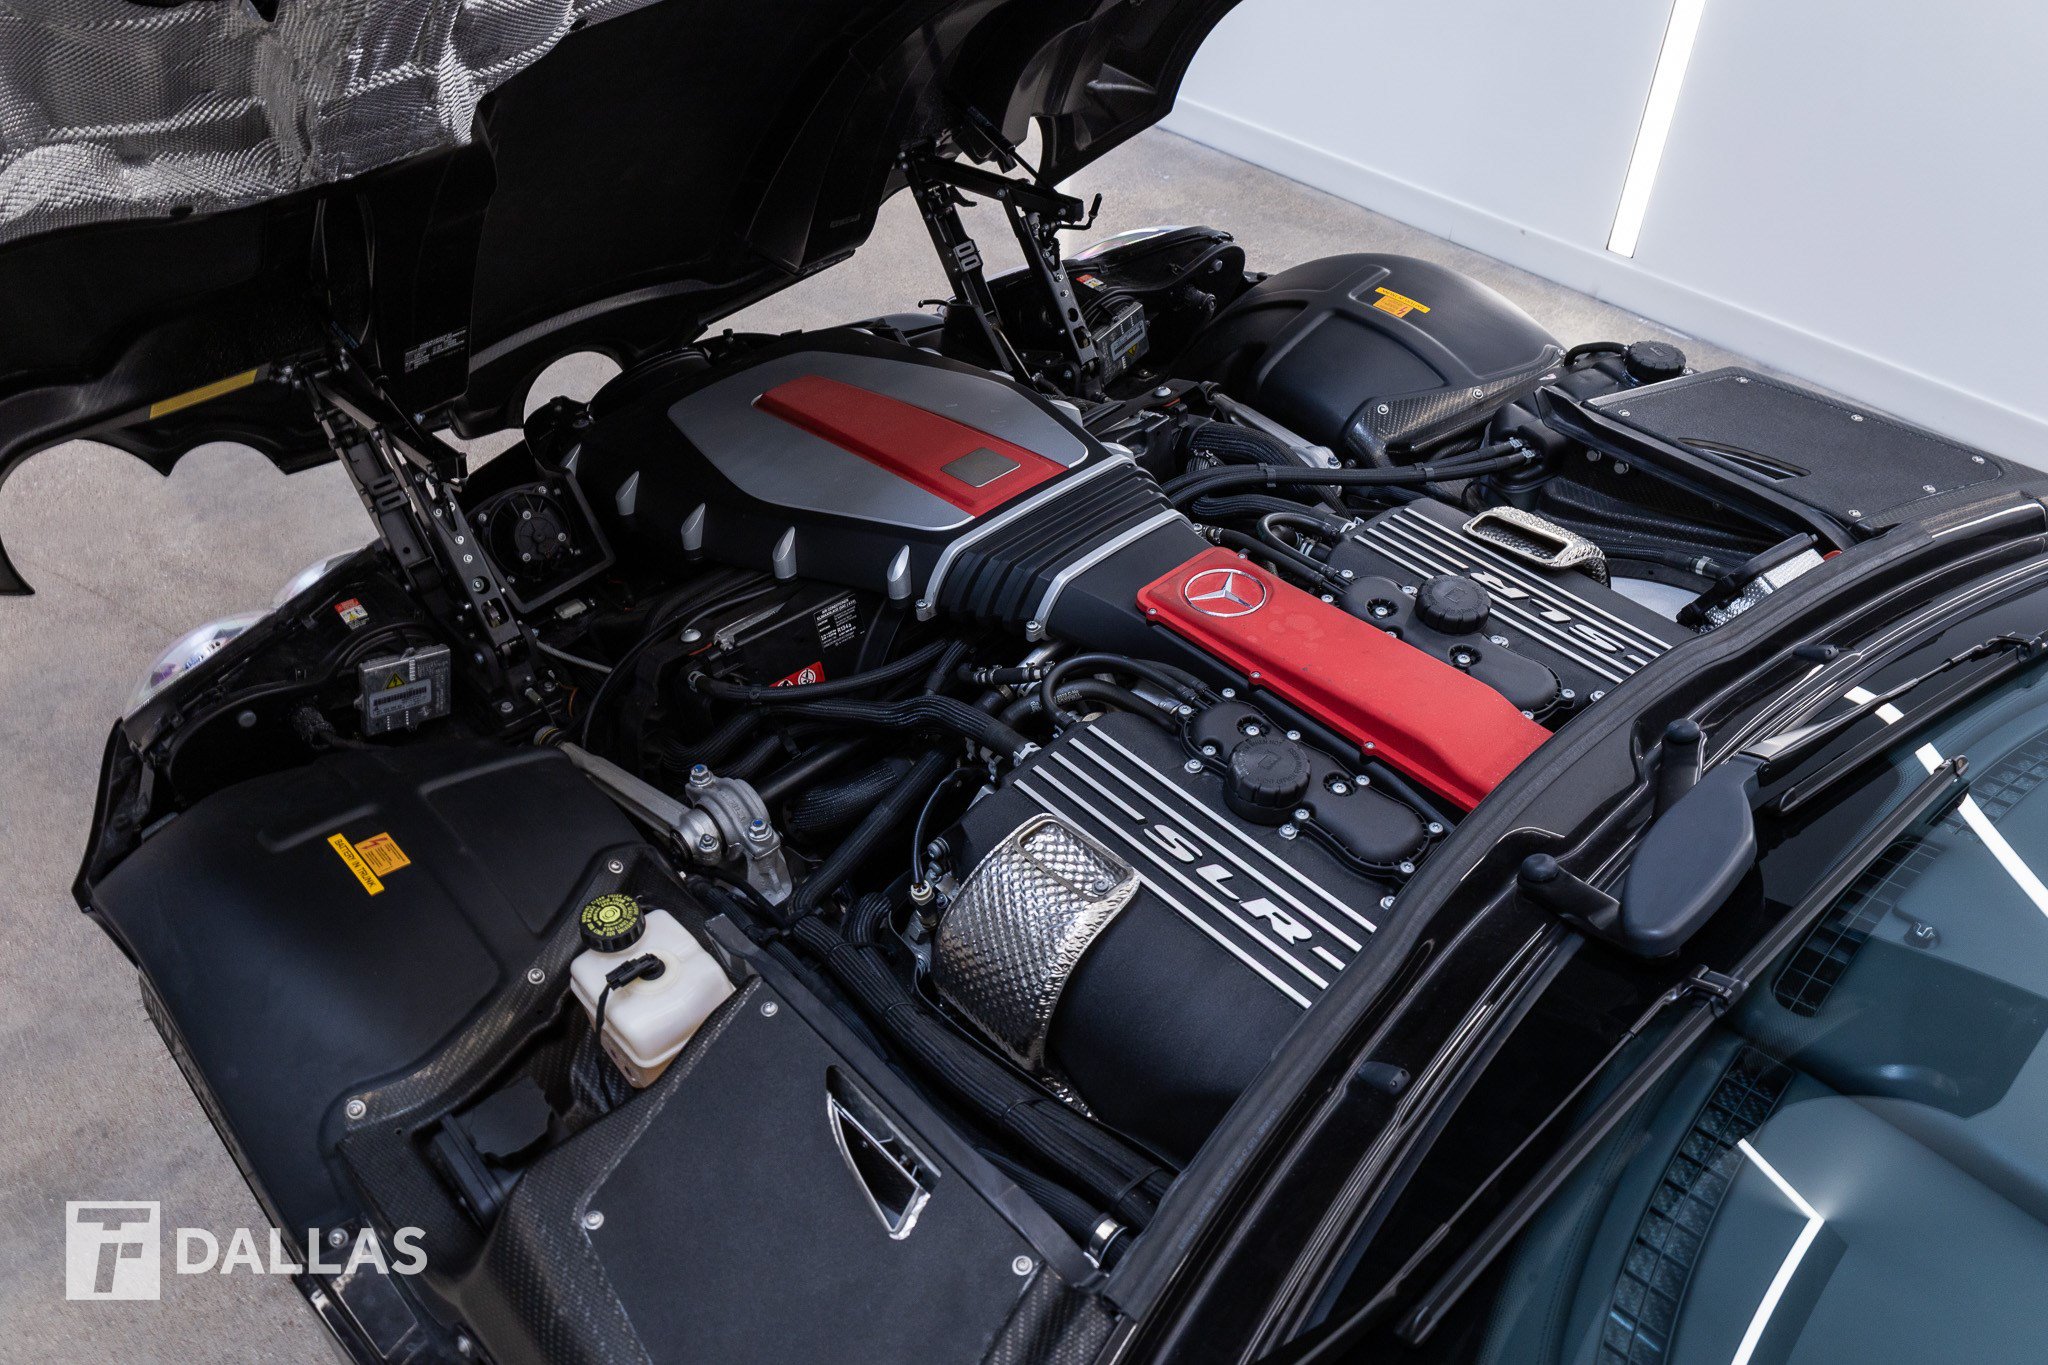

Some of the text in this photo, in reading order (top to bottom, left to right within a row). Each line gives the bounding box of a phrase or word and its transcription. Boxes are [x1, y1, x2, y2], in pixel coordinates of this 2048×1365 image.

[1470, 571, 1625, 652] SLR
[335, 839, 355, 861] BATTERY
[358, 867, 376, 888] TRUNK
[1144, 824, 1312, 945] SLR
